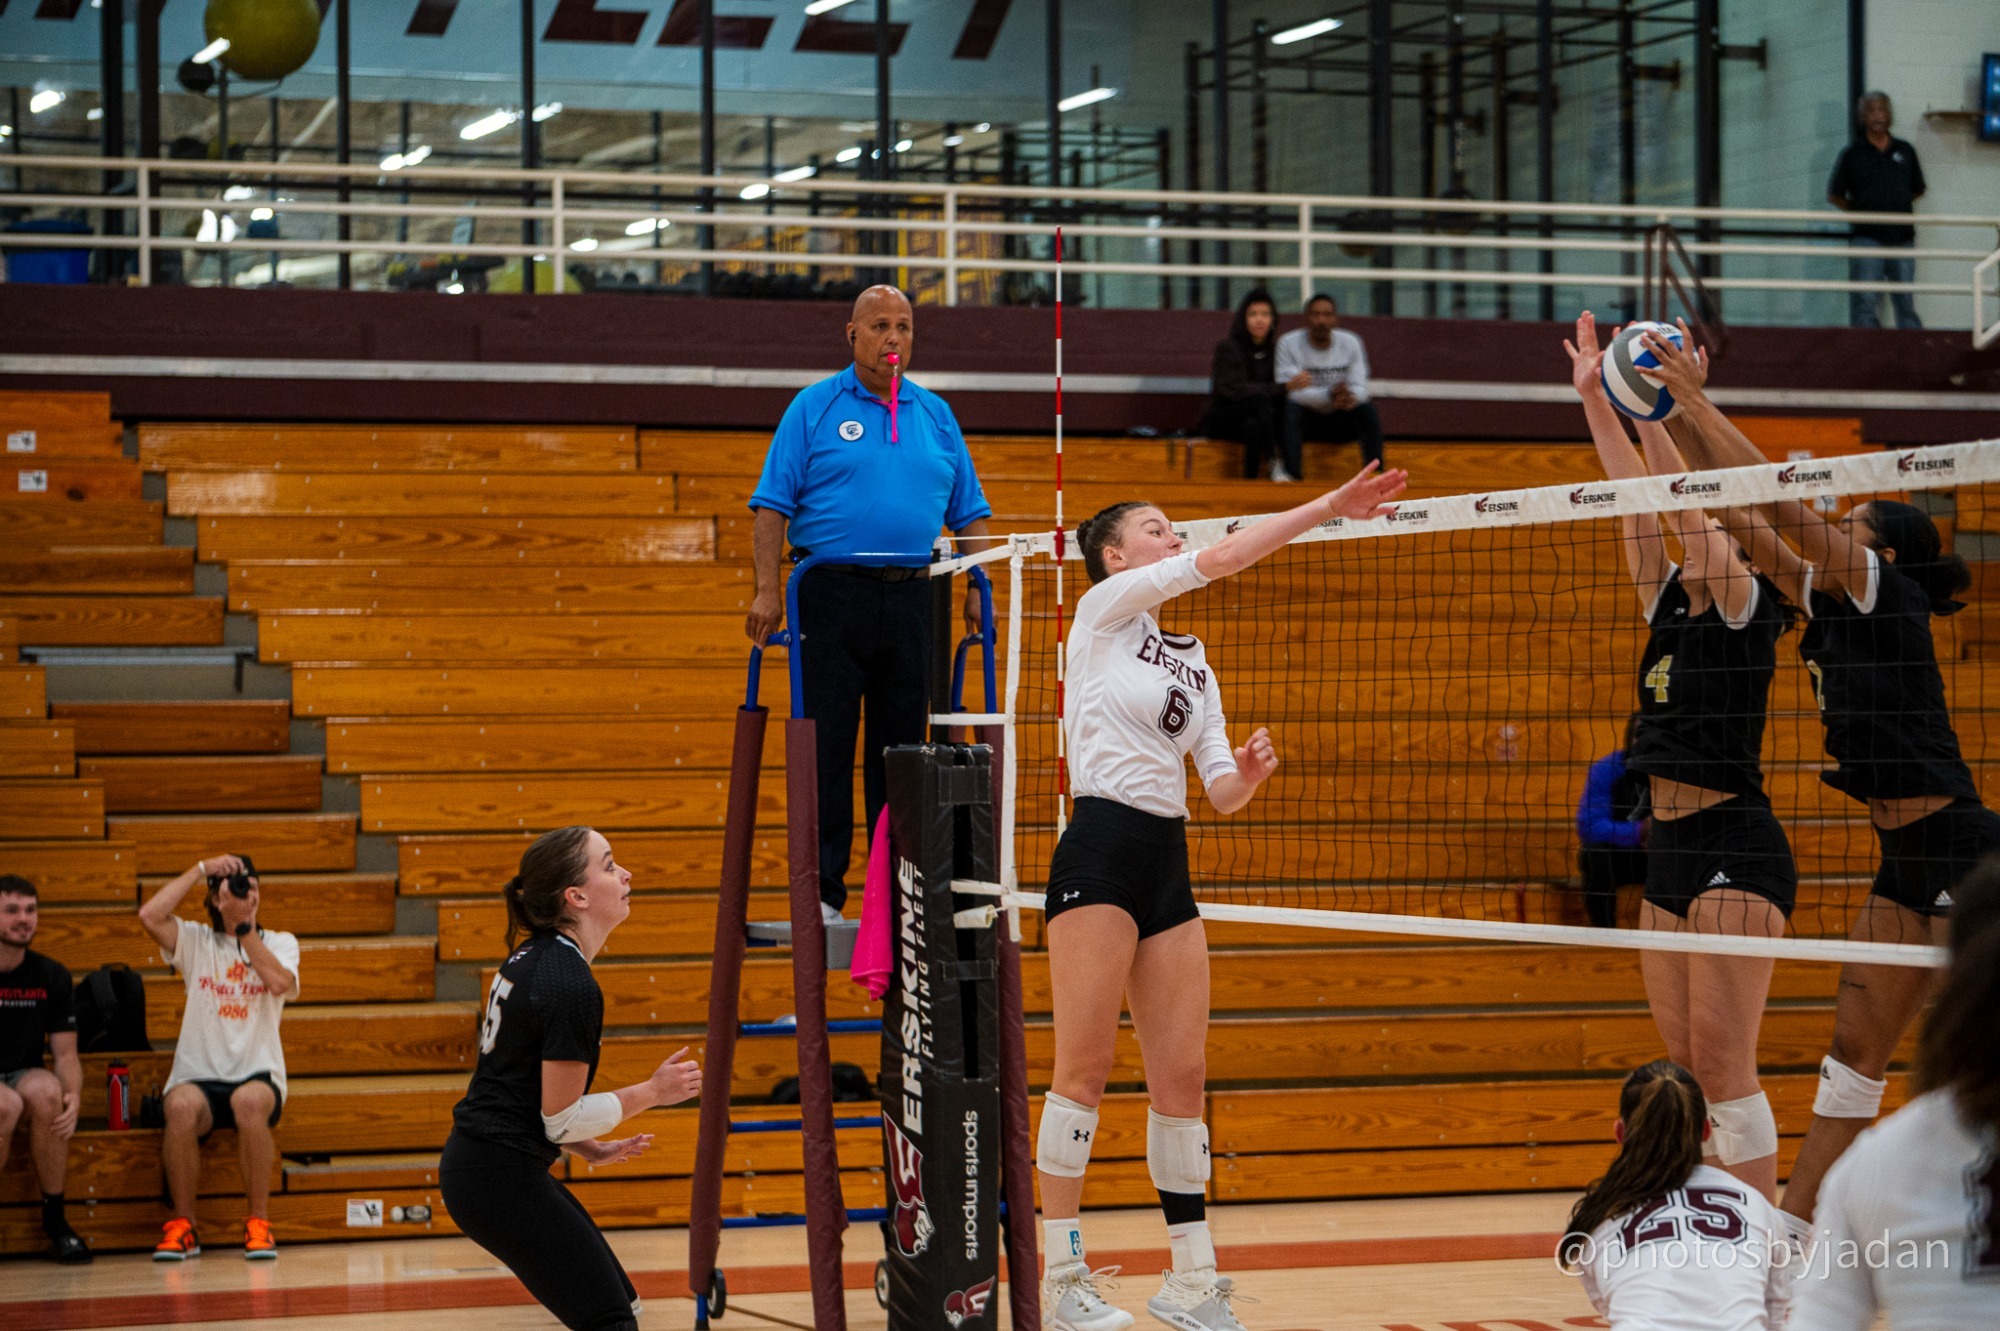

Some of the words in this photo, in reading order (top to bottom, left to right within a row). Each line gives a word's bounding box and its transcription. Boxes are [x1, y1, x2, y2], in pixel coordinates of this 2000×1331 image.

[1685, 482, 1722, 495] ERSKINE
[1795, 470, 1833, 483] ERSKINE
[1914, 458, 1955, 472] ERSKINE
[1398, 510, 1429, 521] ERSKINE
[1488, 501, 1519, 512] ERSKINE
[1583, 492, 1617, 504] ERSKINE
[1645, 654, 1673, 703] 4
[1158, 685, 1193, 738] 6
[914, 864, 927, 948] FLEET
[218, 1004, 249, 1021] 1986
[898, 856, 923, 1136] ERSKINE
[917, 959, 934, 1059] FLYING
[963, 1110, 979, 1177] sports
[963, 1179, 979, 1261] imports
[1618, 1186, 1748, 1251] 25
